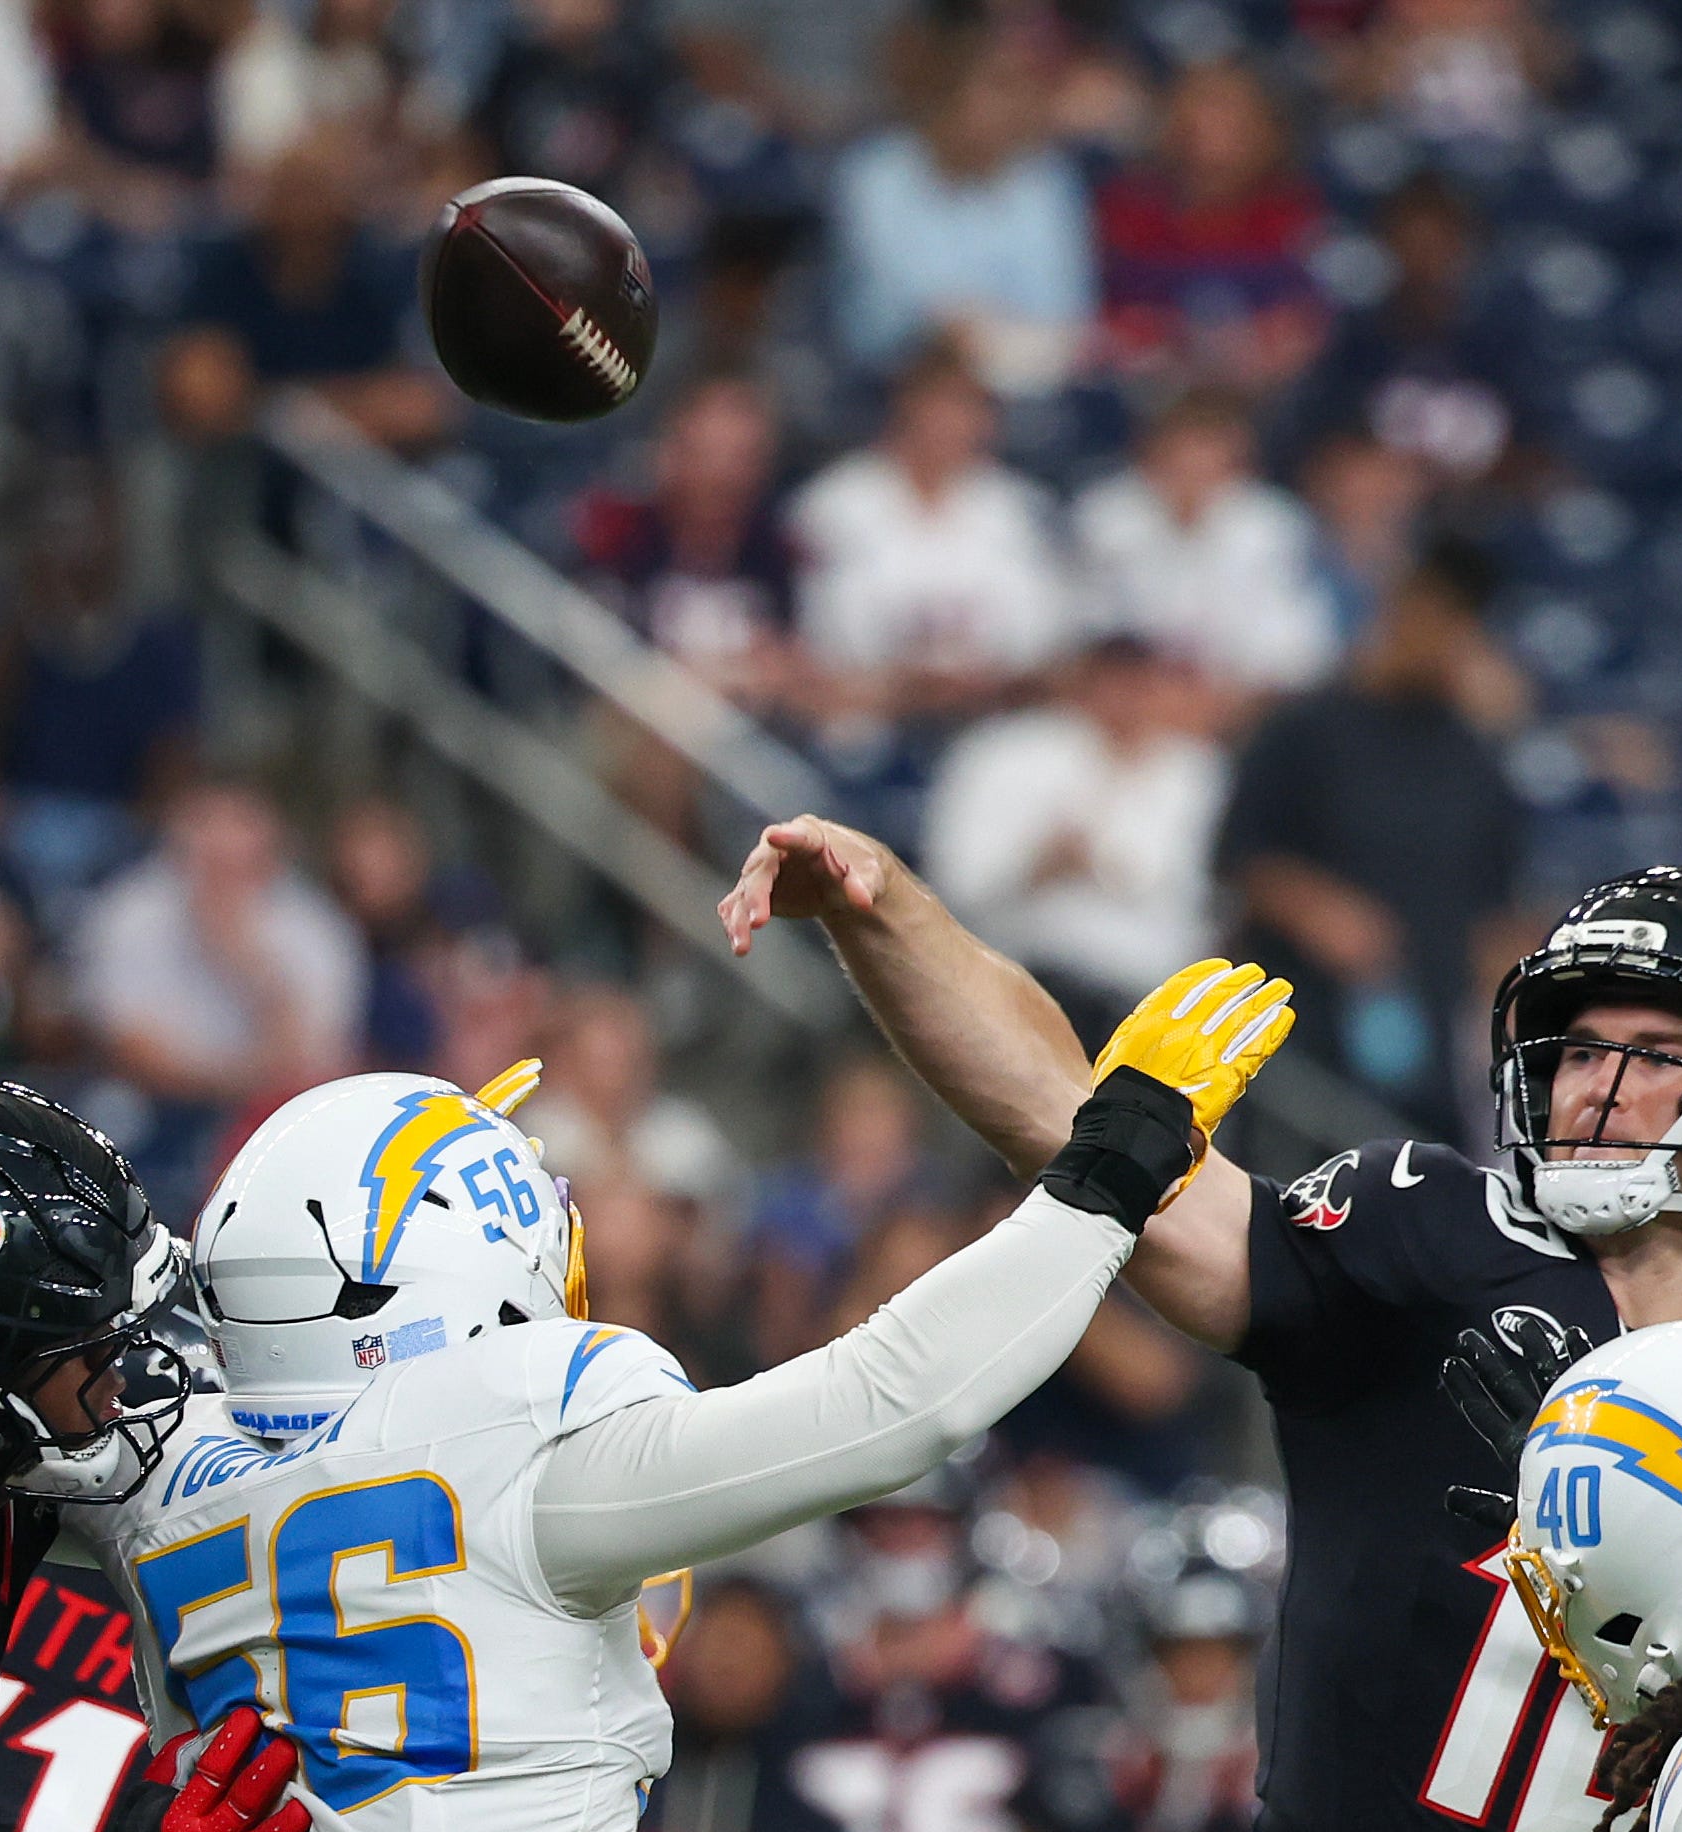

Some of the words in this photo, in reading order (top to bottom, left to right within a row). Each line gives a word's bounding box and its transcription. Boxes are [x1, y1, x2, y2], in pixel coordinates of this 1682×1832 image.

[458, 1147, 540, 1243] 56
[358, 1348, 383, 1367] NFL
[232, 1410, 338, 1437] CHARGE
[1536, 1465, 1601, 1550] 40
[133, 1470, 479, 1815] 56
